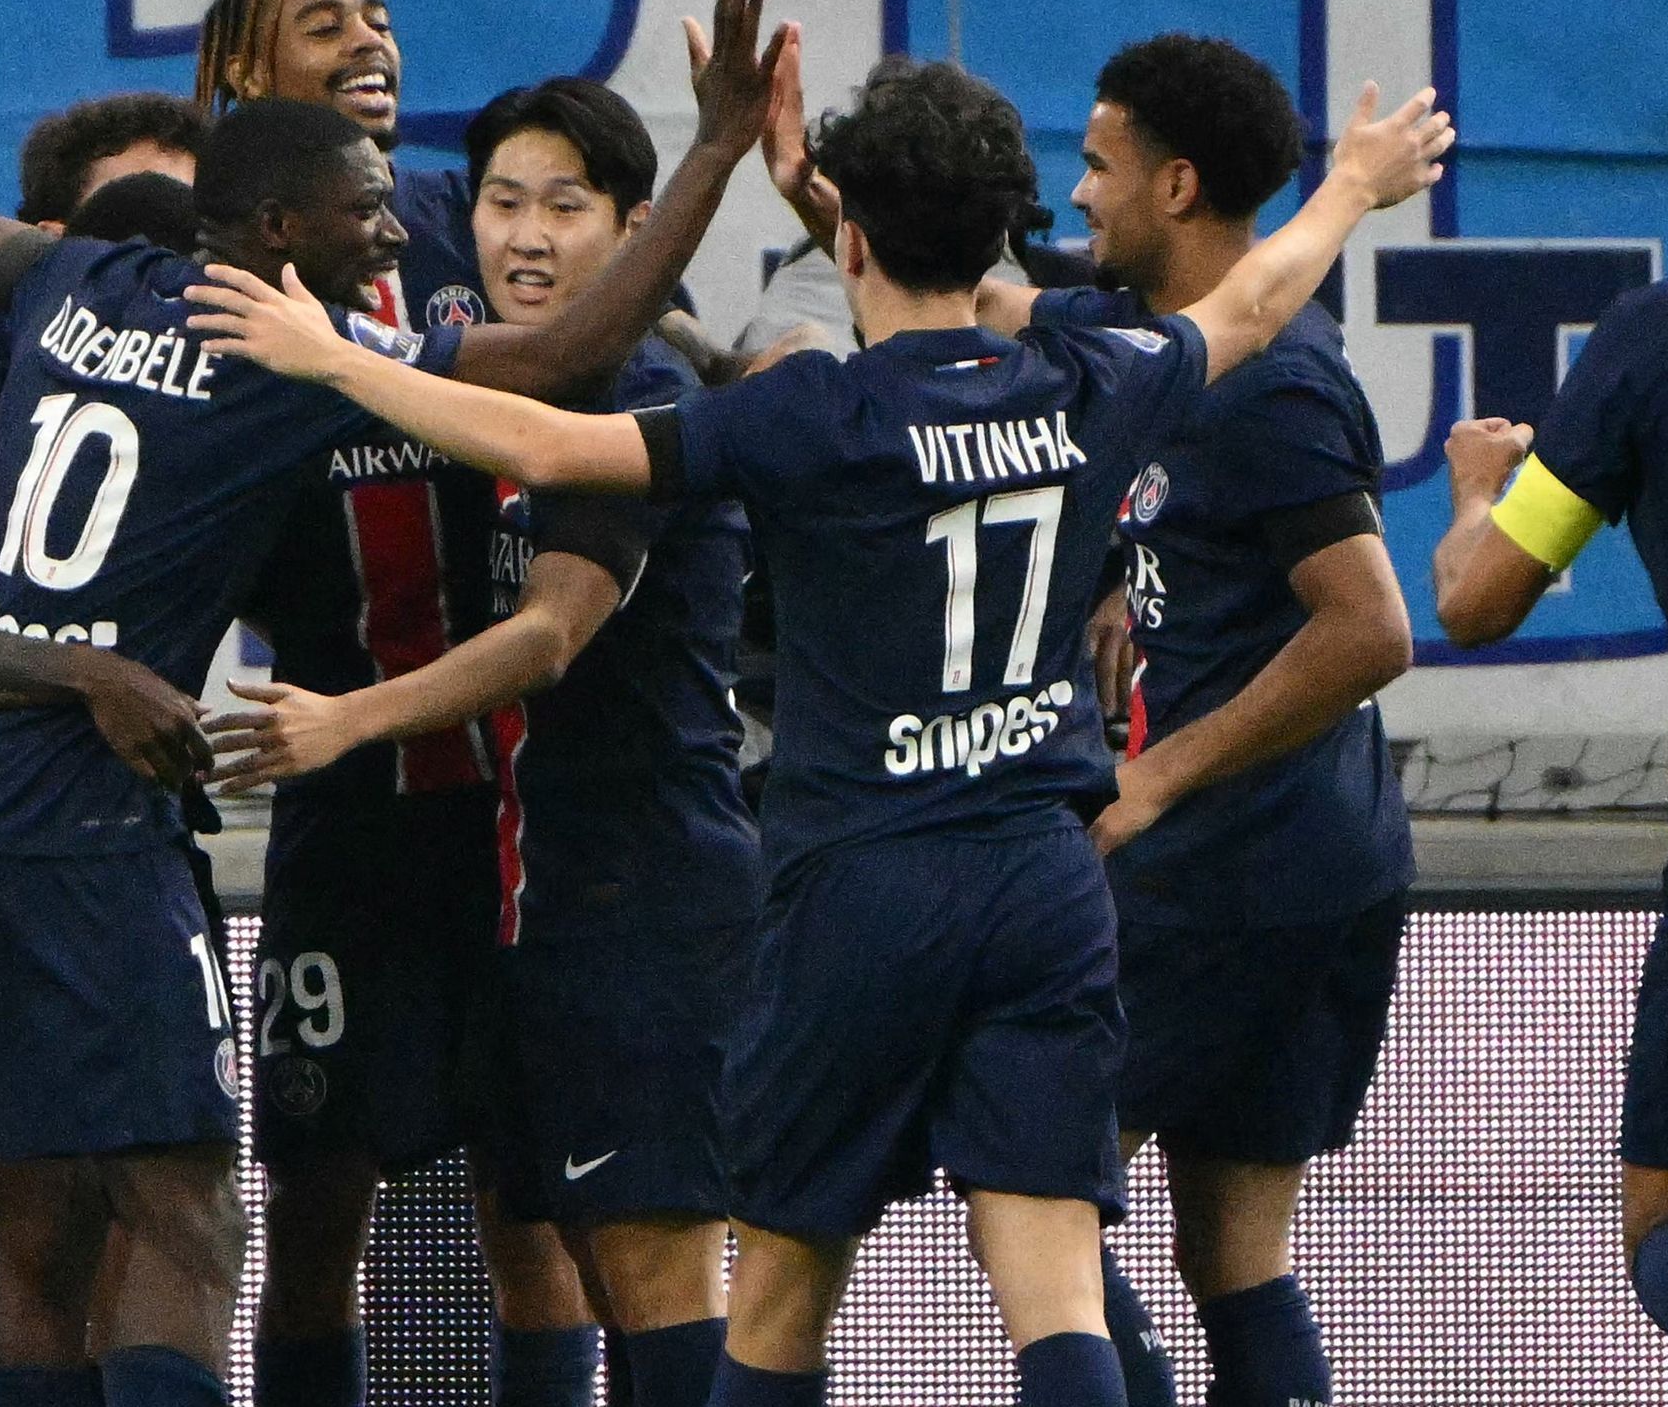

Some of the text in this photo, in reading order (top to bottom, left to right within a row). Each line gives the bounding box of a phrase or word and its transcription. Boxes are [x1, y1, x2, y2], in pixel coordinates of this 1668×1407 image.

[907, 411, 1088, 484] VITINHA
[925, 485, 1066, 693] 17
[884, 680, 1074, 777] snipes
[258, 950, 346, 1057] 29
